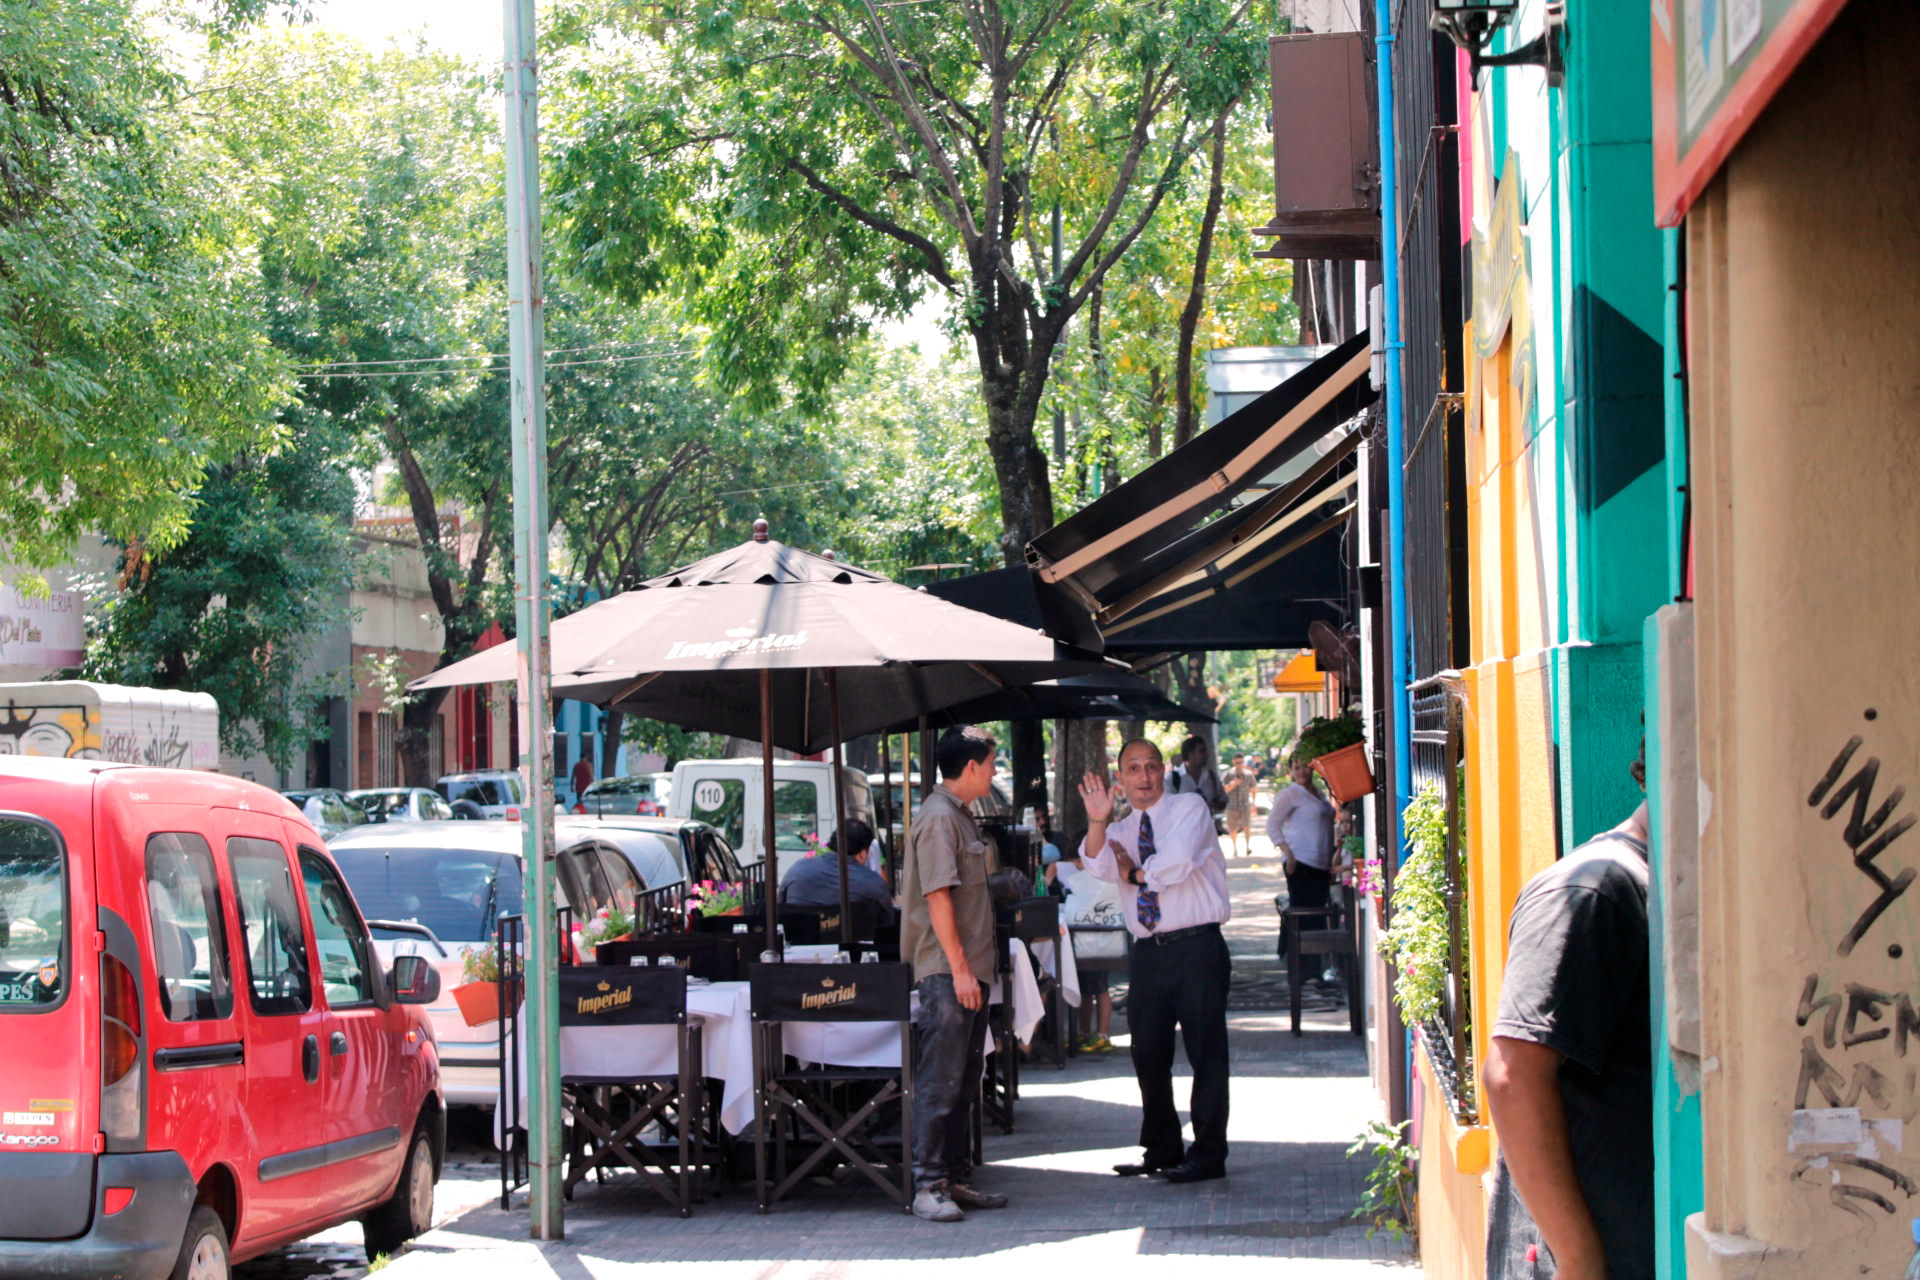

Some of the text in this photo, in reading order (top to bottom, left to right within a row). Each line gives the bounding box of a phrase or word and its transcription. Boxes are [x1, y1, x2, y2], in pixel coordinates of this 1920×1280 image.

[662, 629, 809, 660] Imperial
[700, 787, 721, 804] 110
[577, 985, 633, 1014] Imperial
[801, 982, 857, 1010] Imperial
